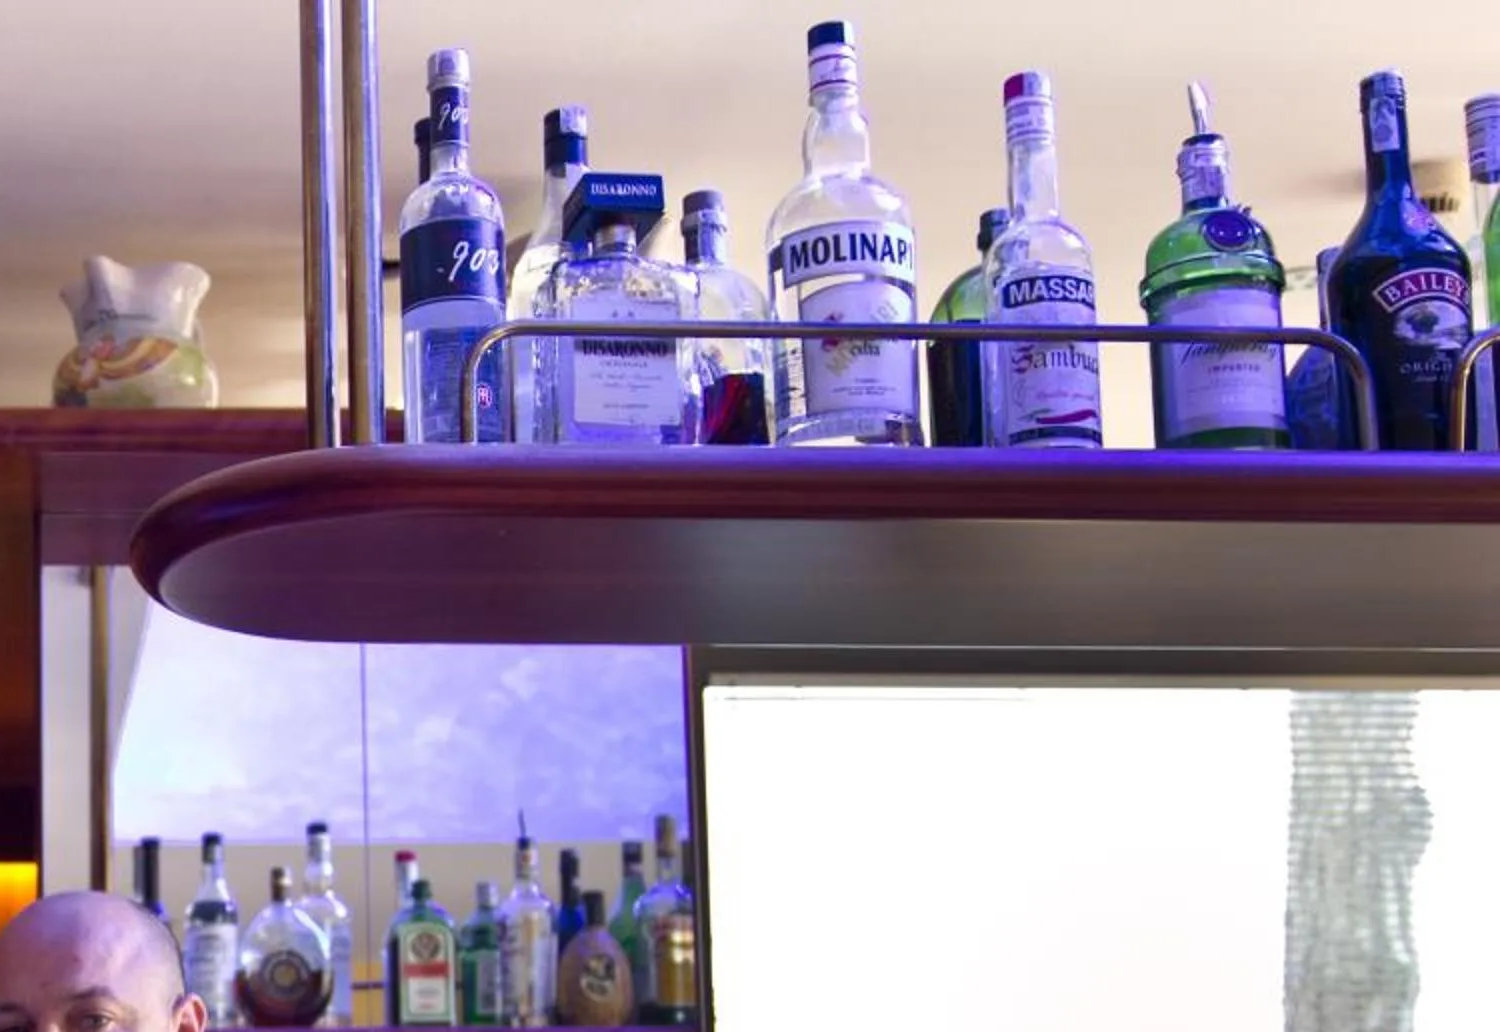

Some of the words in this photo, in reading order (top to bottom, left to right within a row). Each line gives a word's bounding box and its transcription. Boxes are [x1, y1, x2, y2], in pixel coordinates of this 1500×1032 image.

[590, 182, 657, 197] DISARONNO
[448, 240, 501, 281] 903
[583, 338, 668, 358] DISARONNO
